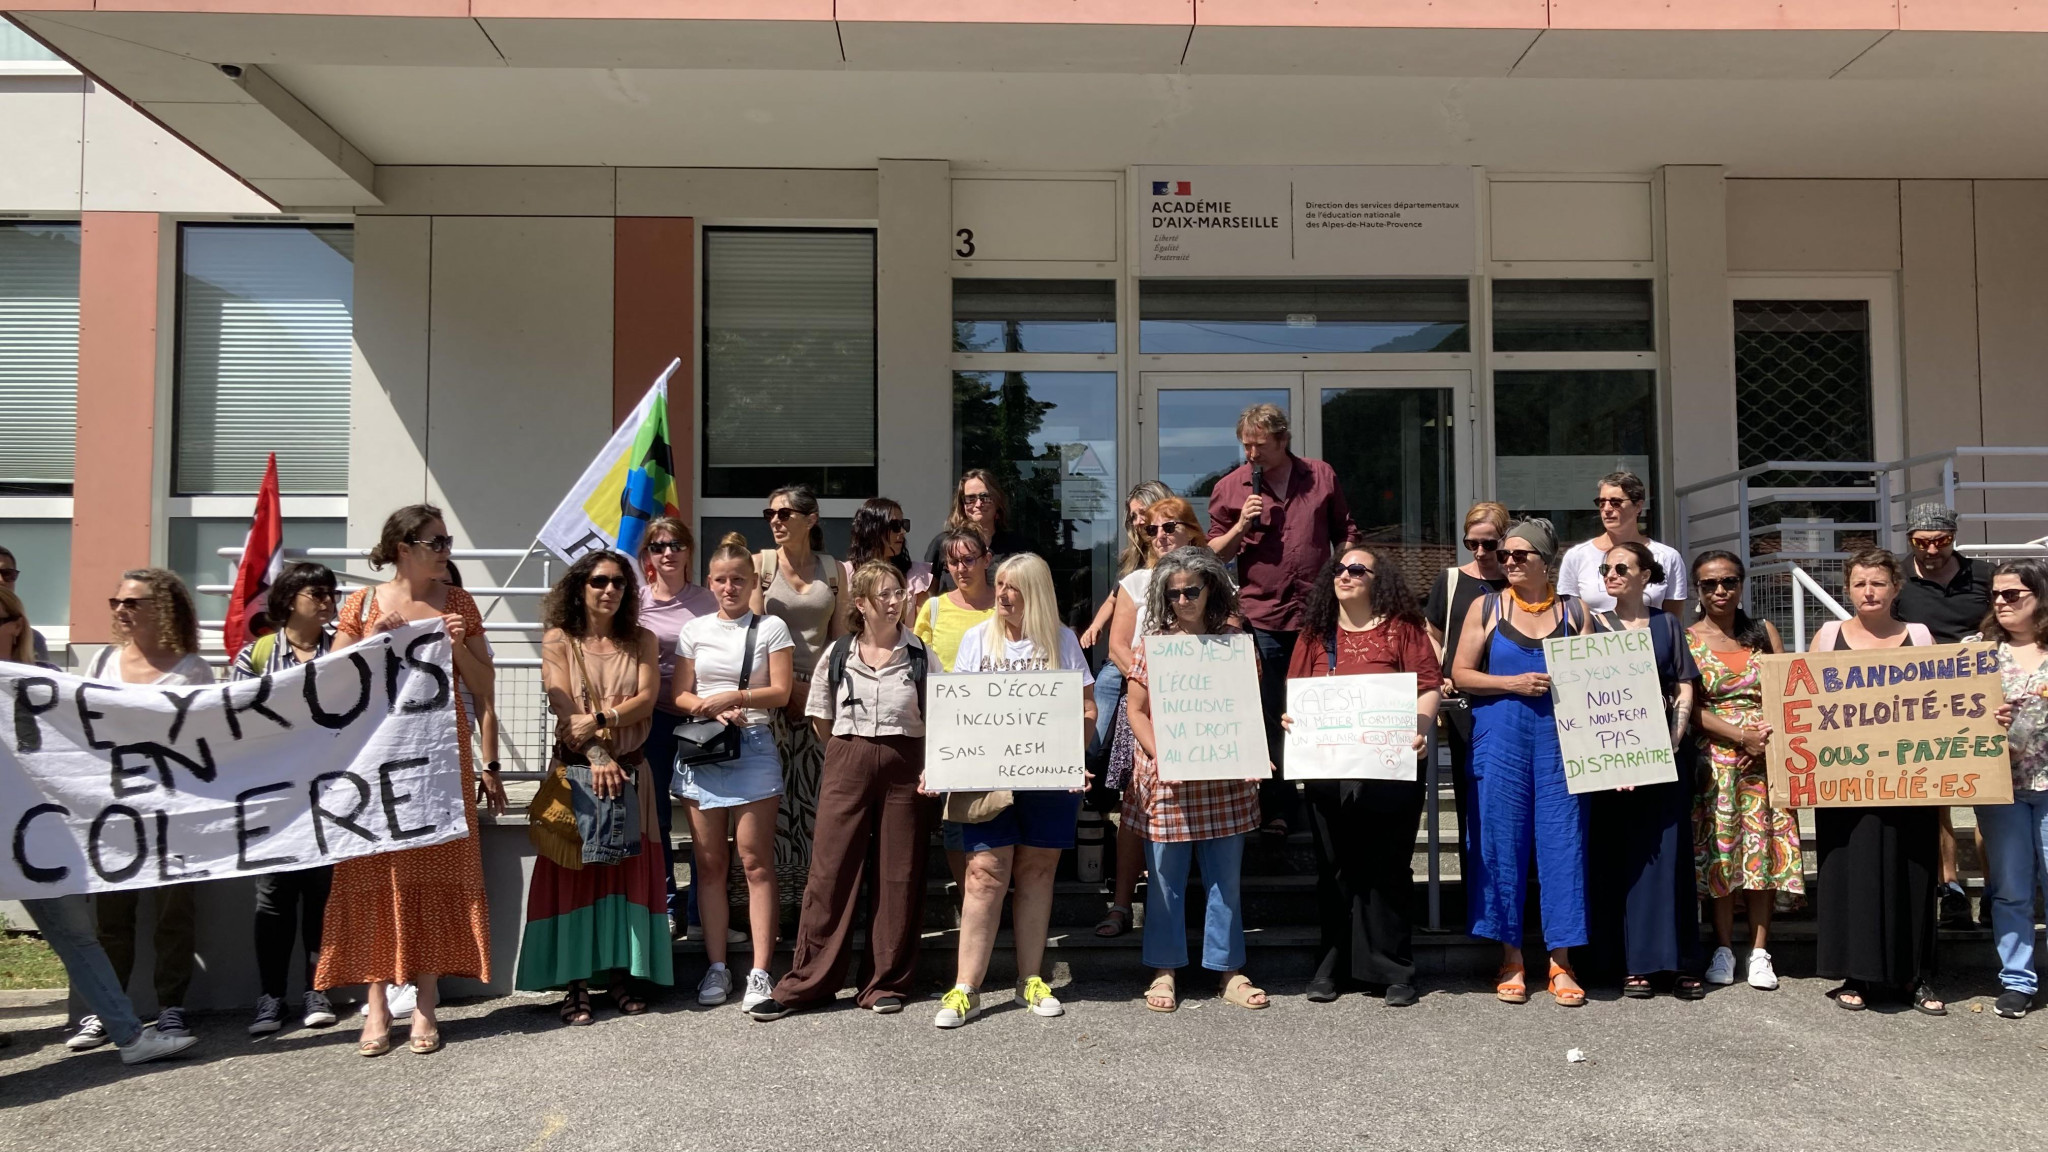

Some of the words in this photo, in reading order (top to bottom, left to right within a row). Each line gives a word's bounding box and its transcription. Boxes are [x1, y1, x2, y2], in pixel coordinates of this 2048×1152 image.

[1152, 199, 1232, 213] ACADÉMIE
[1393, 202, 1460, 211] départementaux
[1152, 216, 1279, 229] D'AIX-MARSEILLE
[1321, 221, 1423, 230] Alpes-de-Haute-Provence
[956, 228, 975, 258] 3
[1154, 234, 1179, 242] Liberté
[1154, 243, 1180, 253] Égalité
[1154, 253, 1191, 261] Fraternité
[1153, 640, 1195, 657] SANS
[1200, 639, 1247, 663] AESH
[1550, 632, 1650, 663] FERMER
[1551, 670, 1581, 687] LES
[1585, 664, 1621, 690] YEUX
[1628, 661, 1655, 677] SUR
[13, 631, 450, 753] PEYRUIS
[936, 683, 971, 699] PAS
[988, 678, 1064, 698] D'ÉCOLE
[1587, 687, 1633, 709] NOUS
[1301, 688, 1364, 713] AESH
[1165, 721, 1187, 740] VA
[1195, 720, 1242, 738] DROIT
[1558, 717, 1583, 734] NE
[1291, 735, 1308, 746] UN
[1596, 729, 1641, 749] PAS
[939, 745, 986, 761] SANS
[1004, 741, 1045, 757] AESH
[1164, 748, 1182, 764] AU
[1188, 740, 1240, 763] CLASH
[110, 736, 217, 798] EN
[12, 757, 437, 883] COLERE
